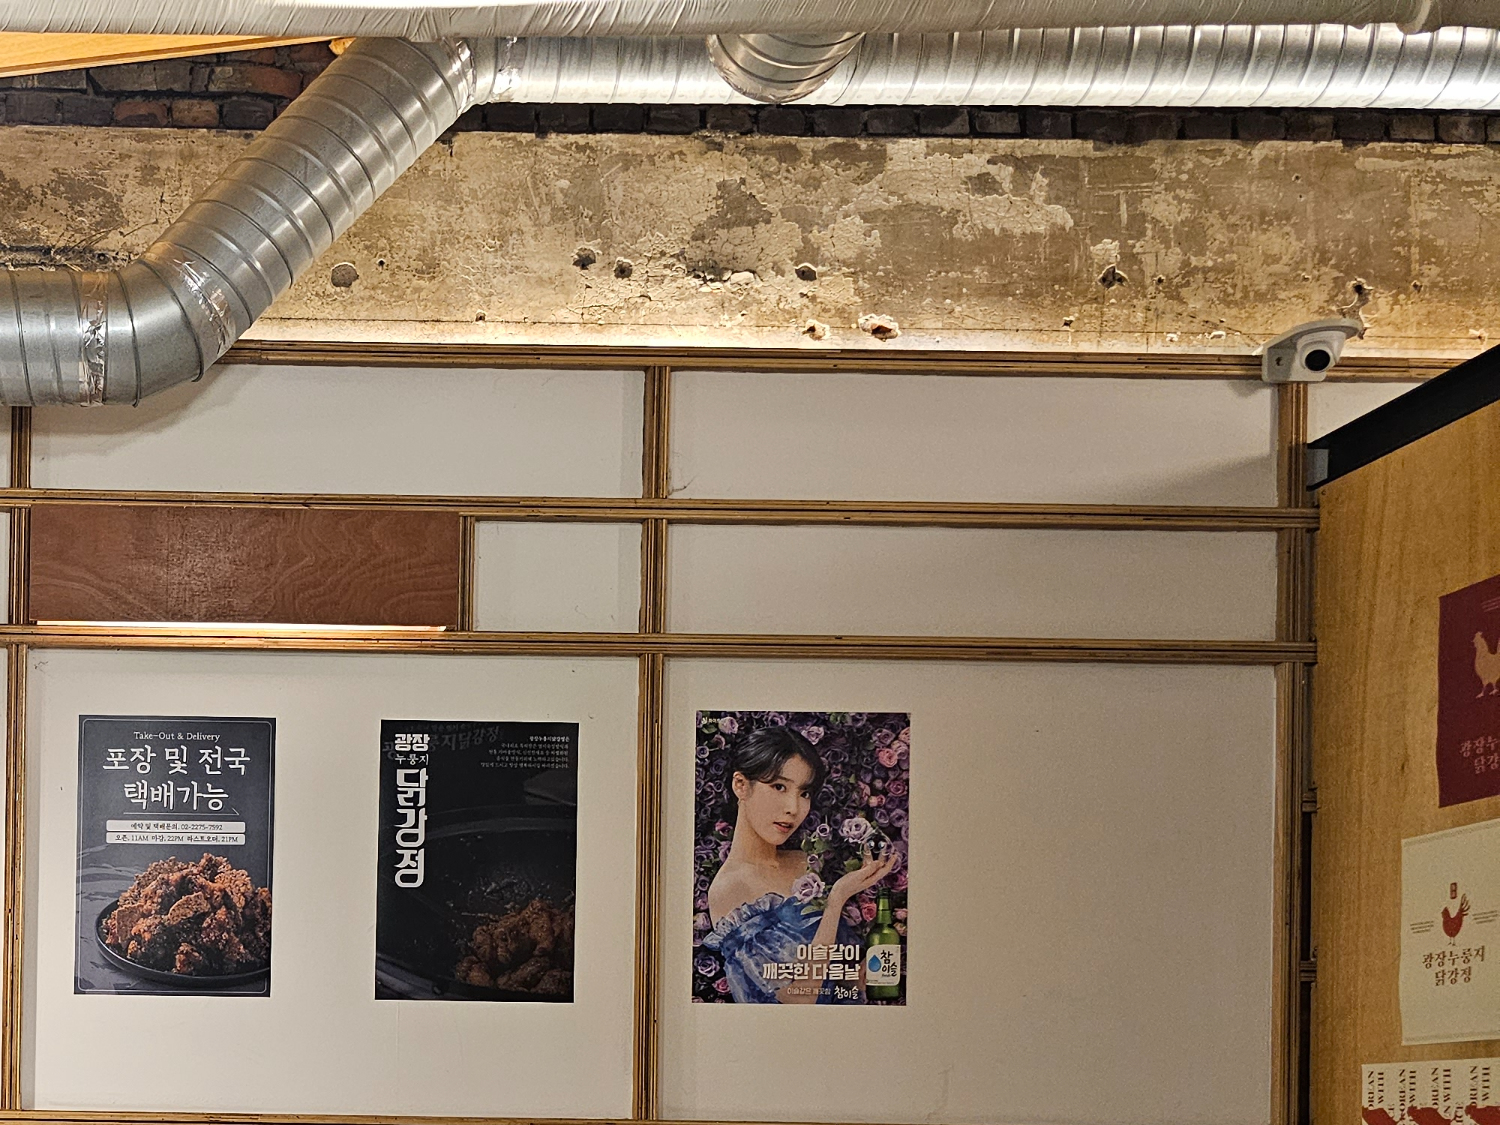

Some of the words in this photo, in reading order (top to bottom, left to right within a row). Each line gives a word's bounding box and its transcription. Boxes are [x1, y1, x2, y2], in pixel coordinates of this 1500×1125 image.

[133, 731, 174, 741] Take-Out
[177, 732, 184, 741] &
[186, 732, 221, 743] Delivery
[394, 733, 431, 752] 광장
[103, 745, 157, 775] 포장
[165, 746, 188, 775] 및
[198, 746, 251, 775] 전국
[394, 753, 430, 766] 누룽지
[123, 781, 229, 811] 택배가능
[394, 768, 429, 888] 닭강정
[797, 944, 860, 961] 이슬같이
[1422, 945, 1486, 970] 광장누룽지
[763, 963, 810, 980] 깨끗한
[812, 963, 860, 980] 다음날
[1434, 966, 1473, 987] 닭강정
[834, 985, 859, 999] 참이슬
[1377, 1071, 1385, 1104] WITH
[1408, 1070, 1417, 1103] WITH
[1443, 1069, 1451, 1102] WITH
[1481, 1066, 1491, 1101] WITH
